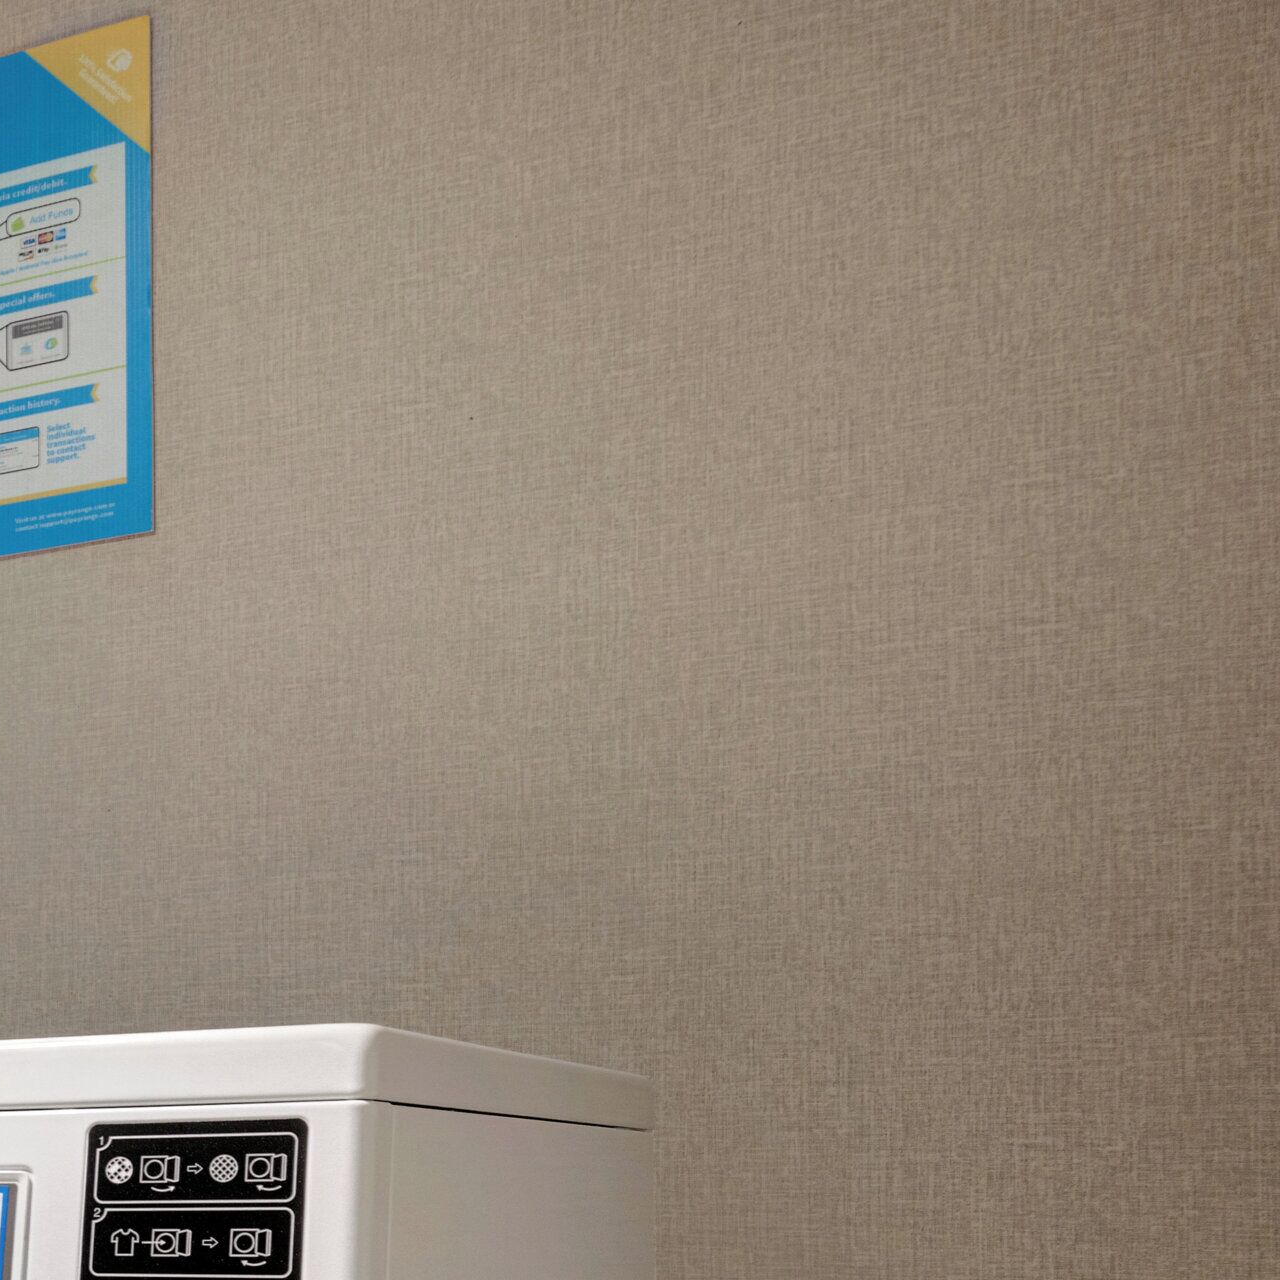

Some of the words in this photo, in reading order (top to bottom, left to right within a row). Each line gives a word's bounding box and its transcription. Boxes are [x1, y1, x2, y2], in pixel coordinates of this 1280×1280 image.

[46, 422, 72, 433] Select
[46, 426, 86, 441] individual
[46, 434, 96, 449] transactions
[46, 449, 55, 457] to
[56, 443, 86, 455] contact
[98, 1136, 104, 1145] 1
[93, 1207, 101, 1218] 2
